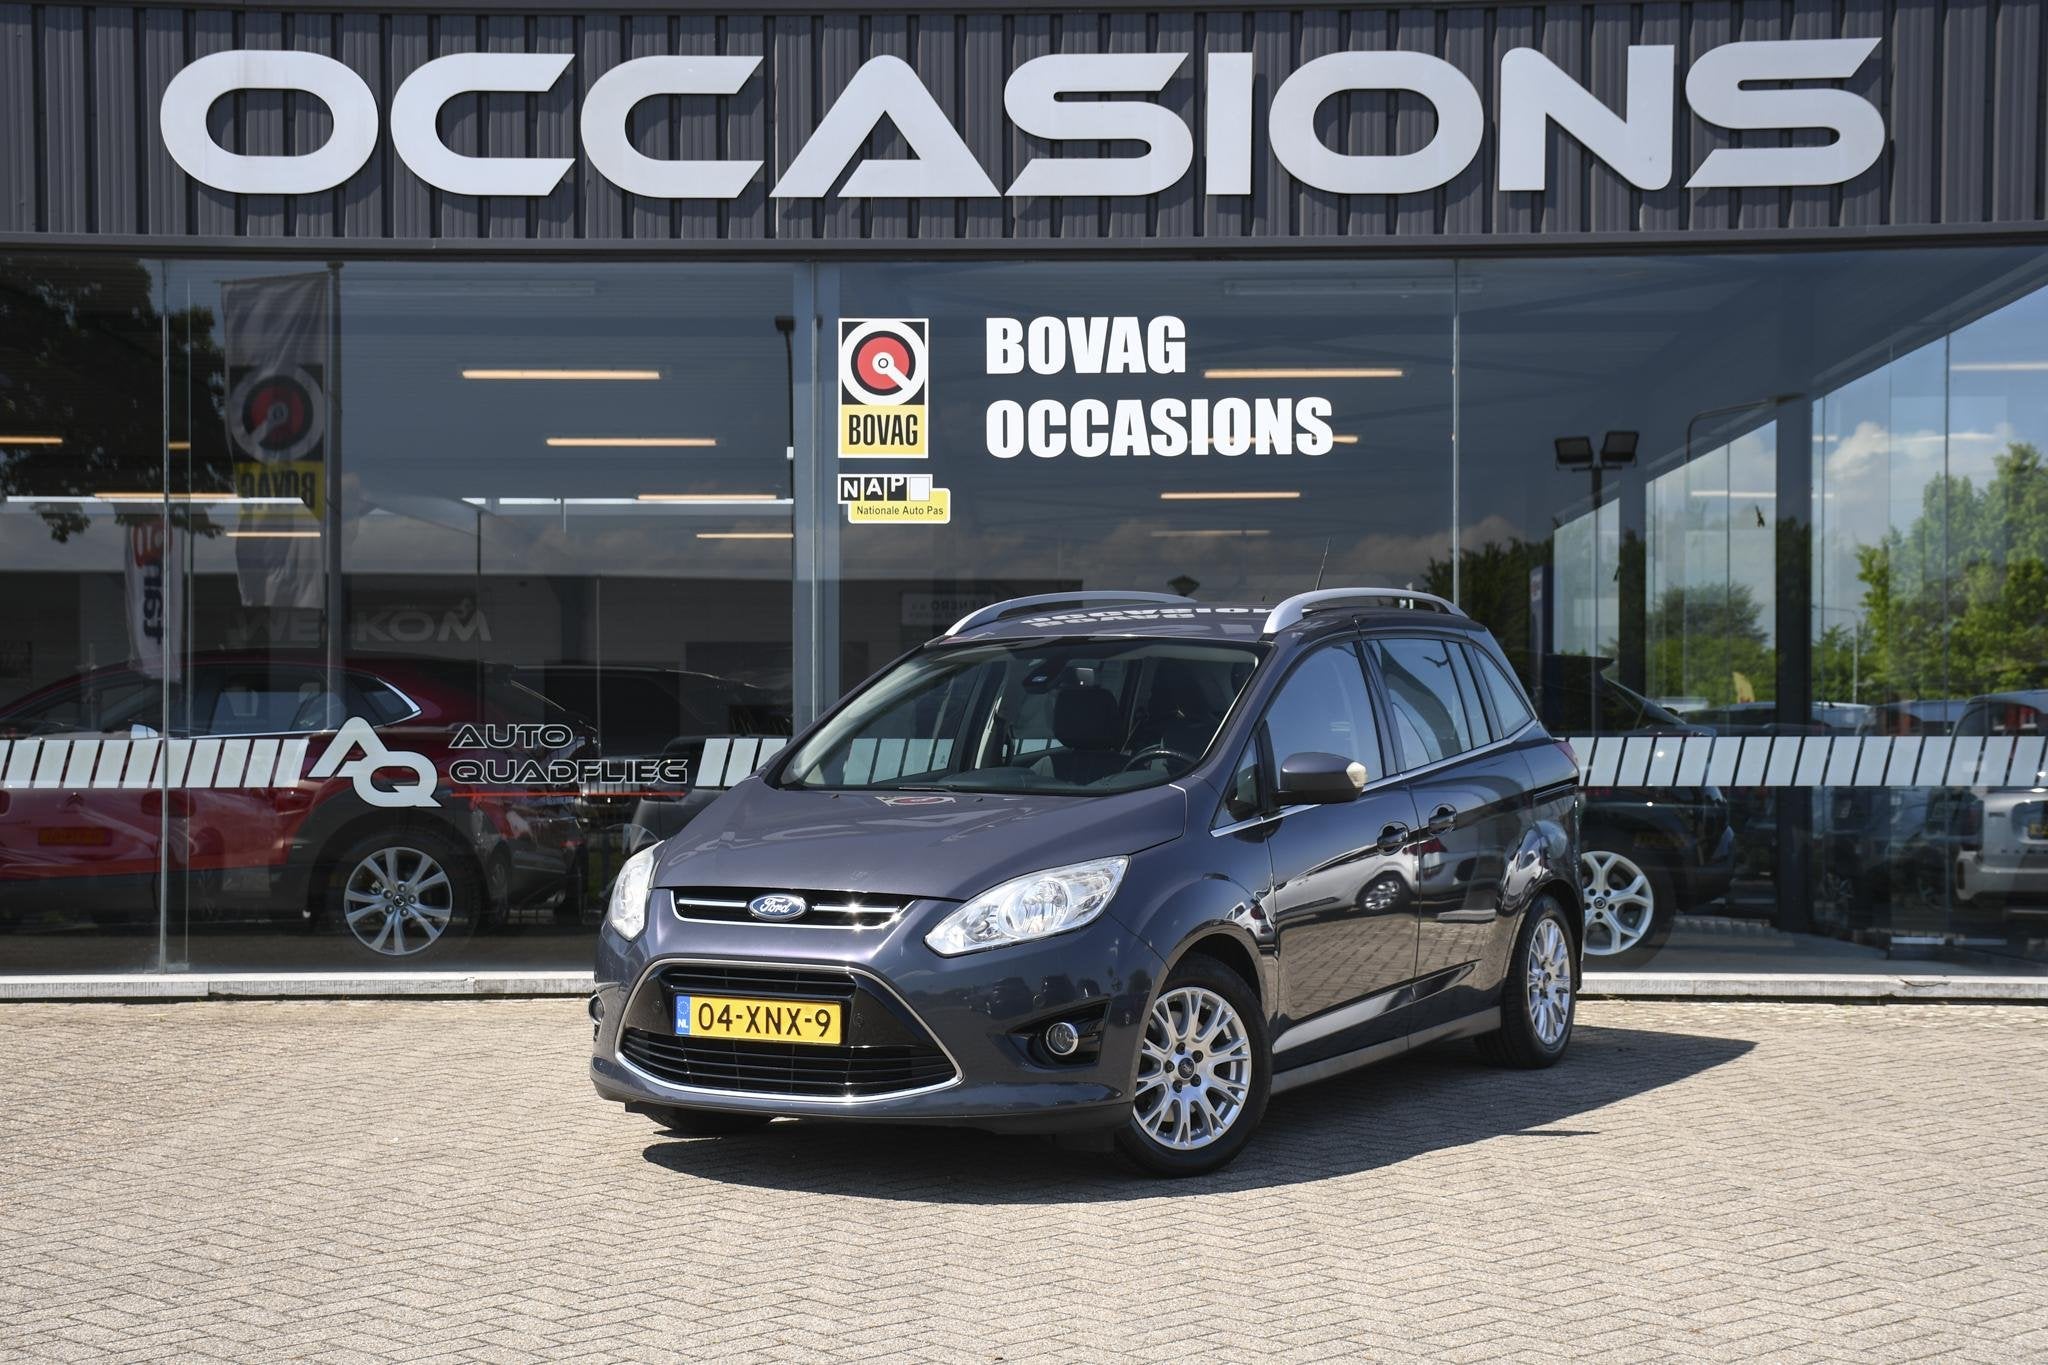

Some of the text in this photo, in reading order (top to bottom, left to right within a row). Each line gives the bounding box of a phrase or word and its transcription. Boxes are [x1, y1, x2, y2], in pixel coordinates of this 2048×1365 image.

[160, 37, 1885, 199] OCCASIONS
[986, 315, 1187, 375] BOVAG
[848, 413, 919, 446] BOVAG
[985, 396, 1334, 459] OCCASIONS
[843, 476, 905, 498] NAP
[856, 505, 944, 515] Nationale Auto Pas
[230, 608, 492, 642] WEKOM
[448, 723, 573, 749] AUTO
[449, 759, 689, 784] QUADFLIEG
[759, 897, 793, 914] Ford
[677, 1002, 831, 1037] NL 04-XNX-9
